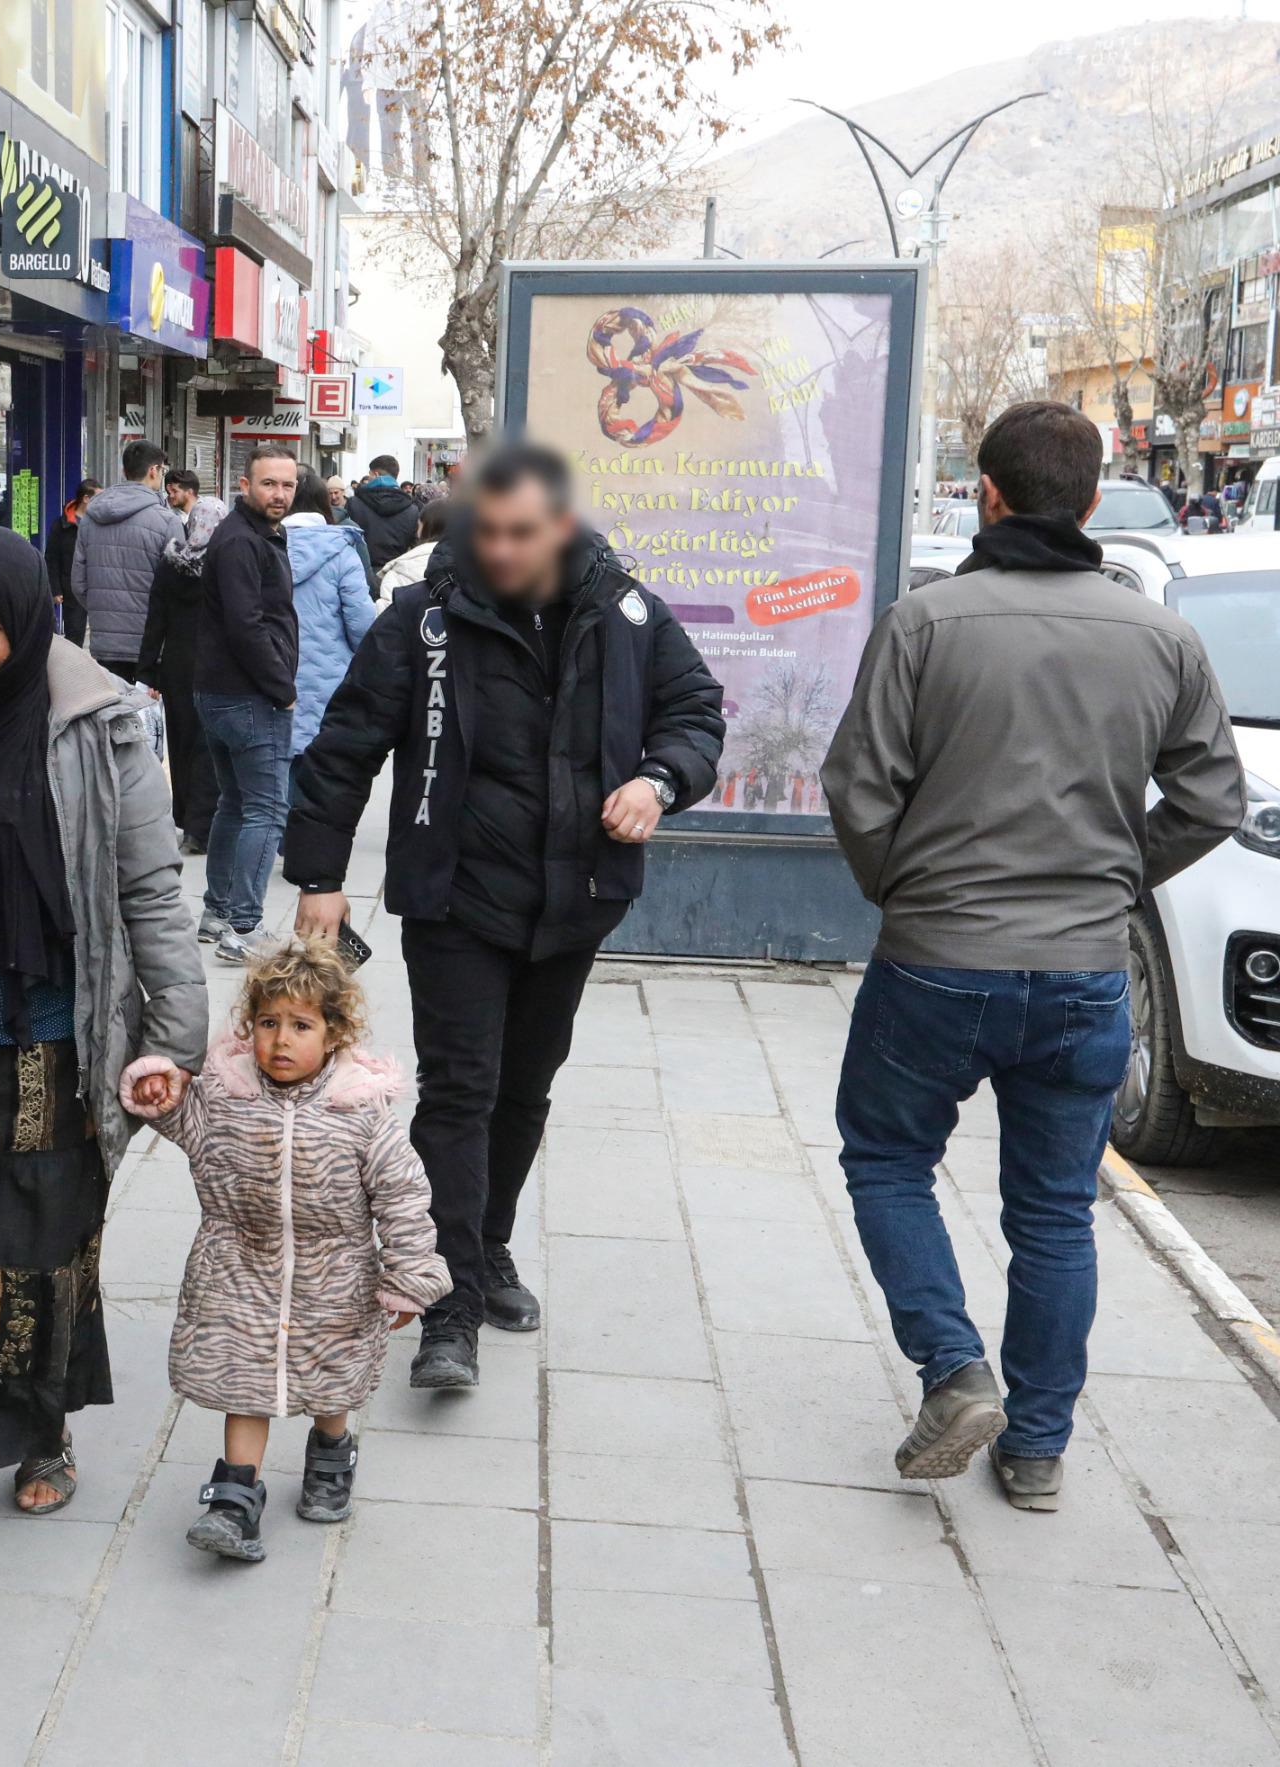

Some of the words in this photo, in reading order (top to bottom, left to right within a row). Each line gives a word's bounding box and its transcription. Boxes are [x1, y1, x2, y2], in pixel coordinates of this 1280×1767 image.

[9, 253, 71, 271] BARGELLO
[317, 384, 340, 412] E
[247, 411, 302, 430] arçelik
[674, 452, 825, 477] Kırımına
[591, 480, 679, 515] İsyan
[689, 487, 800, 518] Ediyor
[607, 521, 776, 558] Özgürlüğe
[627, 560, 780, 591] ürüyoruz
[753, 591, 785, 605] Tüm
[770, 592, 837, 616] Davetlidir
[702, 630, 774, 642] Hatimoğulları
[723, 647, 757, 657] Pervin
[760, 648, 797, 658] Buldan
[414, 650, 447, 826] ZABITA
